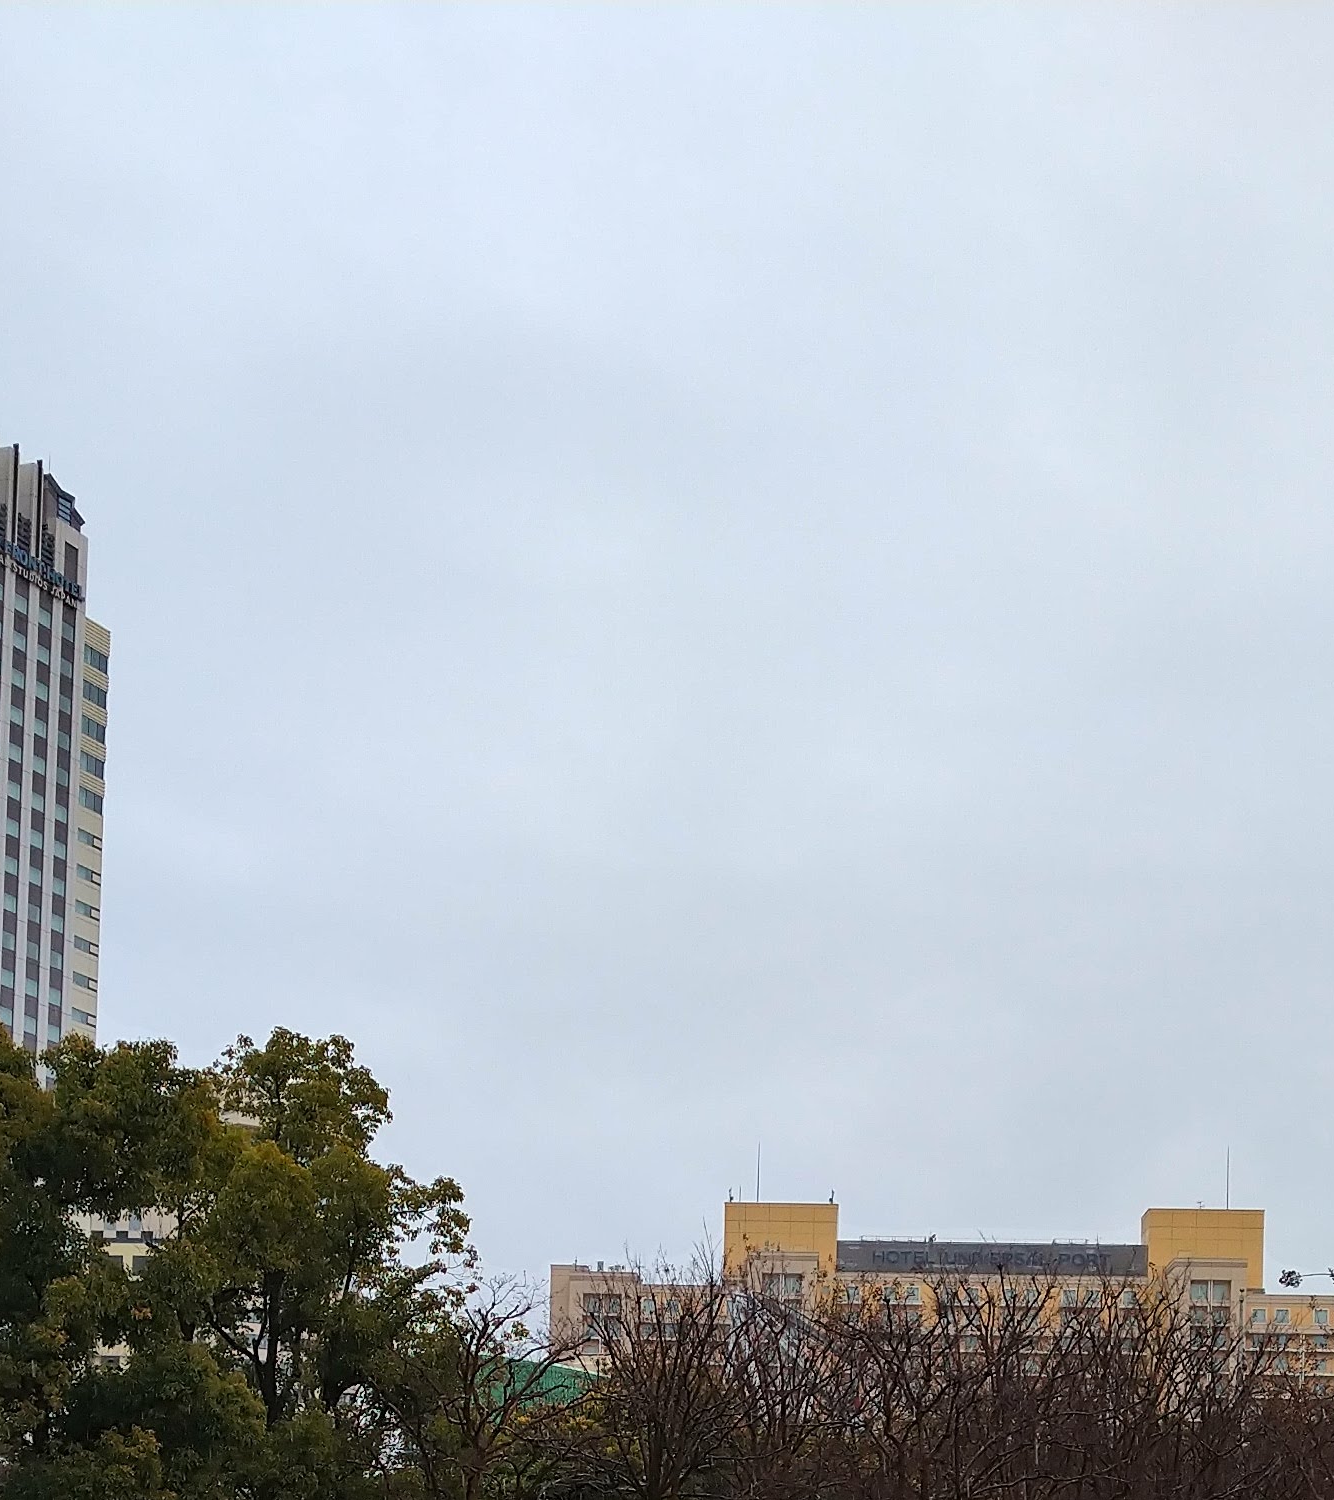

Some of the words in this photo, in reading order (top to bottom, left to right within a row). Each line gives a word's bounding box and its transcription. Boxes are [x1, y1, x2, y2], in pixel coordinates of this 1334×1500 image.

[5, 541, 47, 580] FRONT
[47, 567, 84, 602] HOTEL
[11, 564, 48, 591] STUDIOS
[50, 586, 78, 609] JAPAN
[872, 1250, 935, 1266] HOTEL
[941, 1250, 1043, 1267] UNIVERSAL
[1057, 1252, 1111, 1268] PORT
